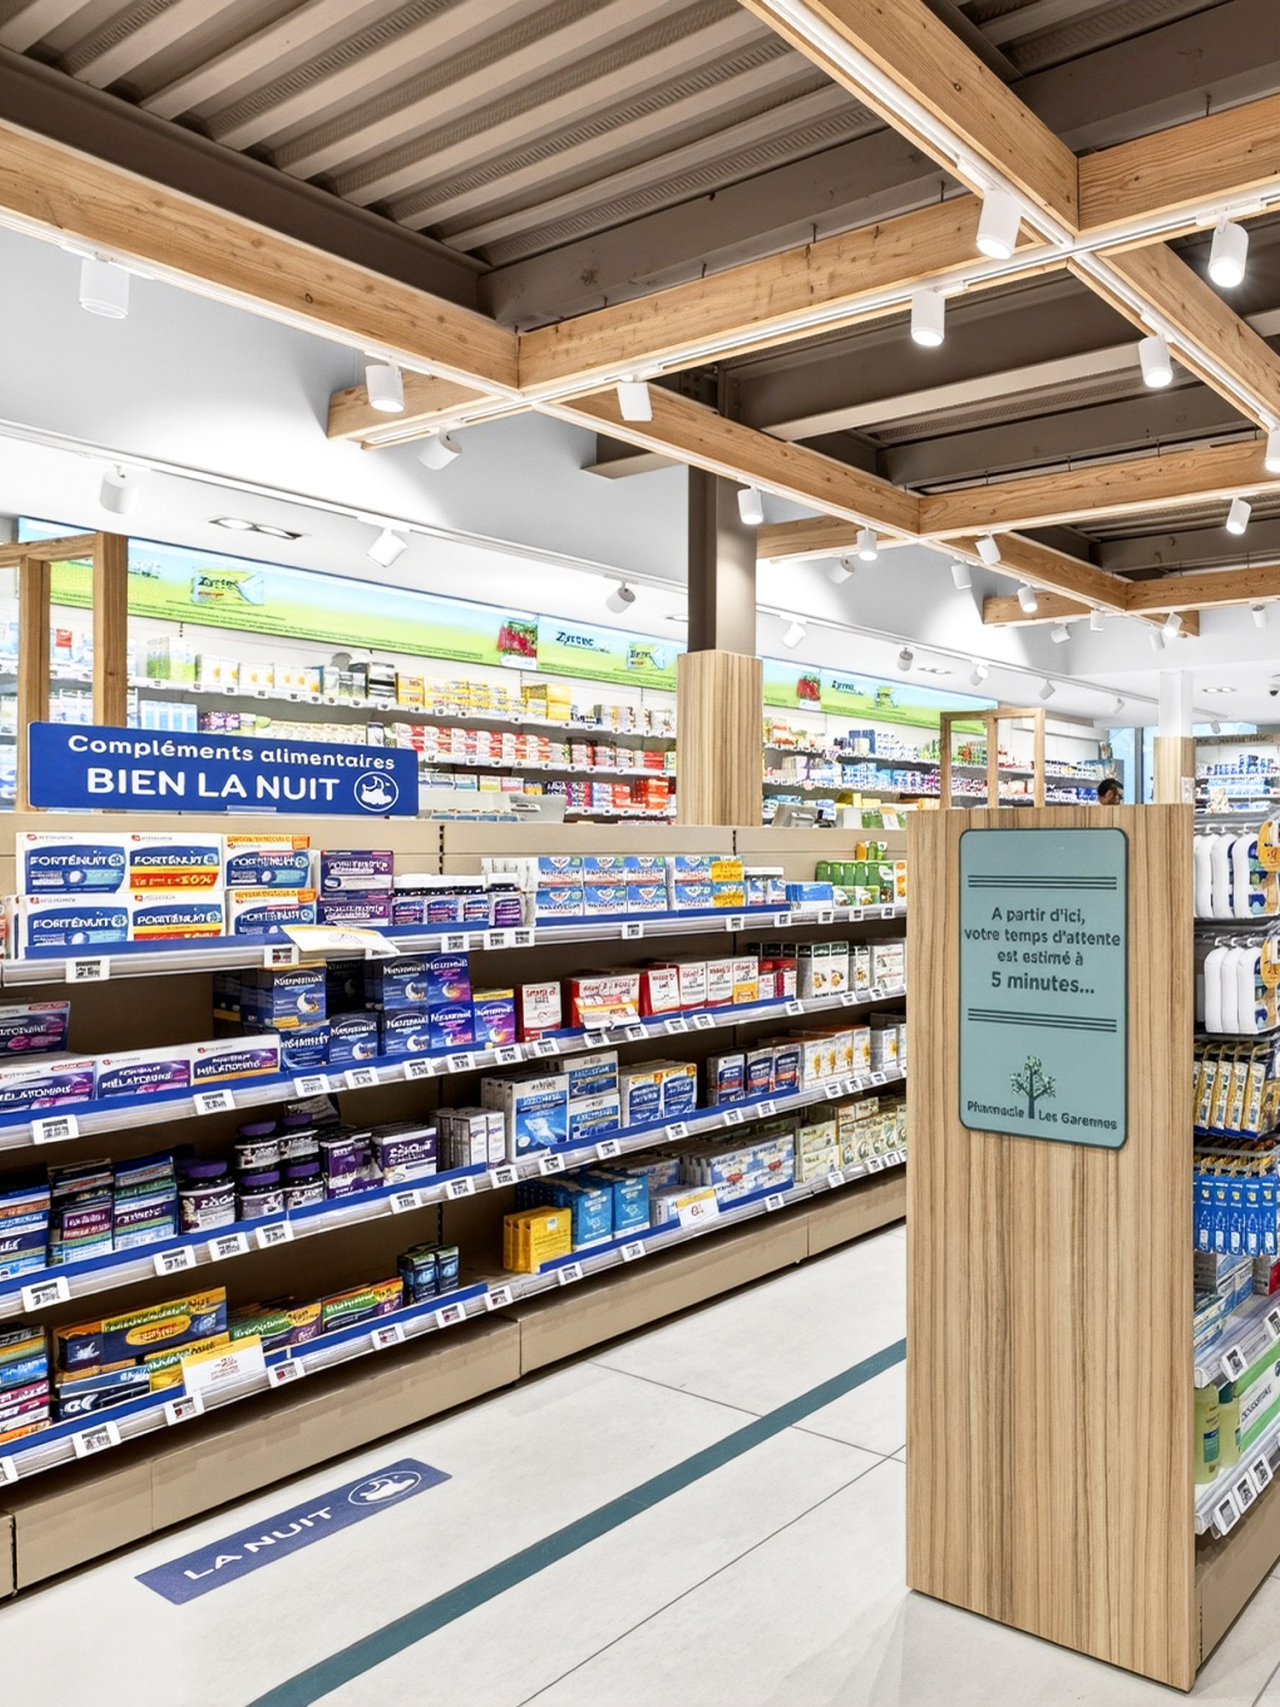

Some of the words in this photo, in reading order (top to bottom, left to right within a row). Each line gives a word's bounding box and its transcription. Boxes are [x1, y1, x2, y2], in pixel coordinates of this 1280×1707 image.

[67, 734, 254, 763] Compléments
[260, 748, 396, 771] alimentaires
[86, 766, 186, 796] BIEN
[197, 771, 248, 798] LA
[257, 774, 341, 801] NUIT
[991, 906, 1003, 922] A
[1006, 907, 1046, 924] partir
[1050, 907, 1086, 926] d'ici,
[964, 928, 1000, 941] votre
[1004, 930, 1049, 946] temps
[1052, 929, 1121, 947] d'attente
[997, 950, 1019, 964] est
[1022, 950, 1071, 966] estimé
[1074, 951, 1084, 967] à
[991, 971, 1002, 988] 5
[1007, 972, 1096, 995] minutes...
[1038, 1109, 1059, 1124] Les
[183, 1554, 243, 1581] LA
[243, 1506, 332, 1553] NUIT
